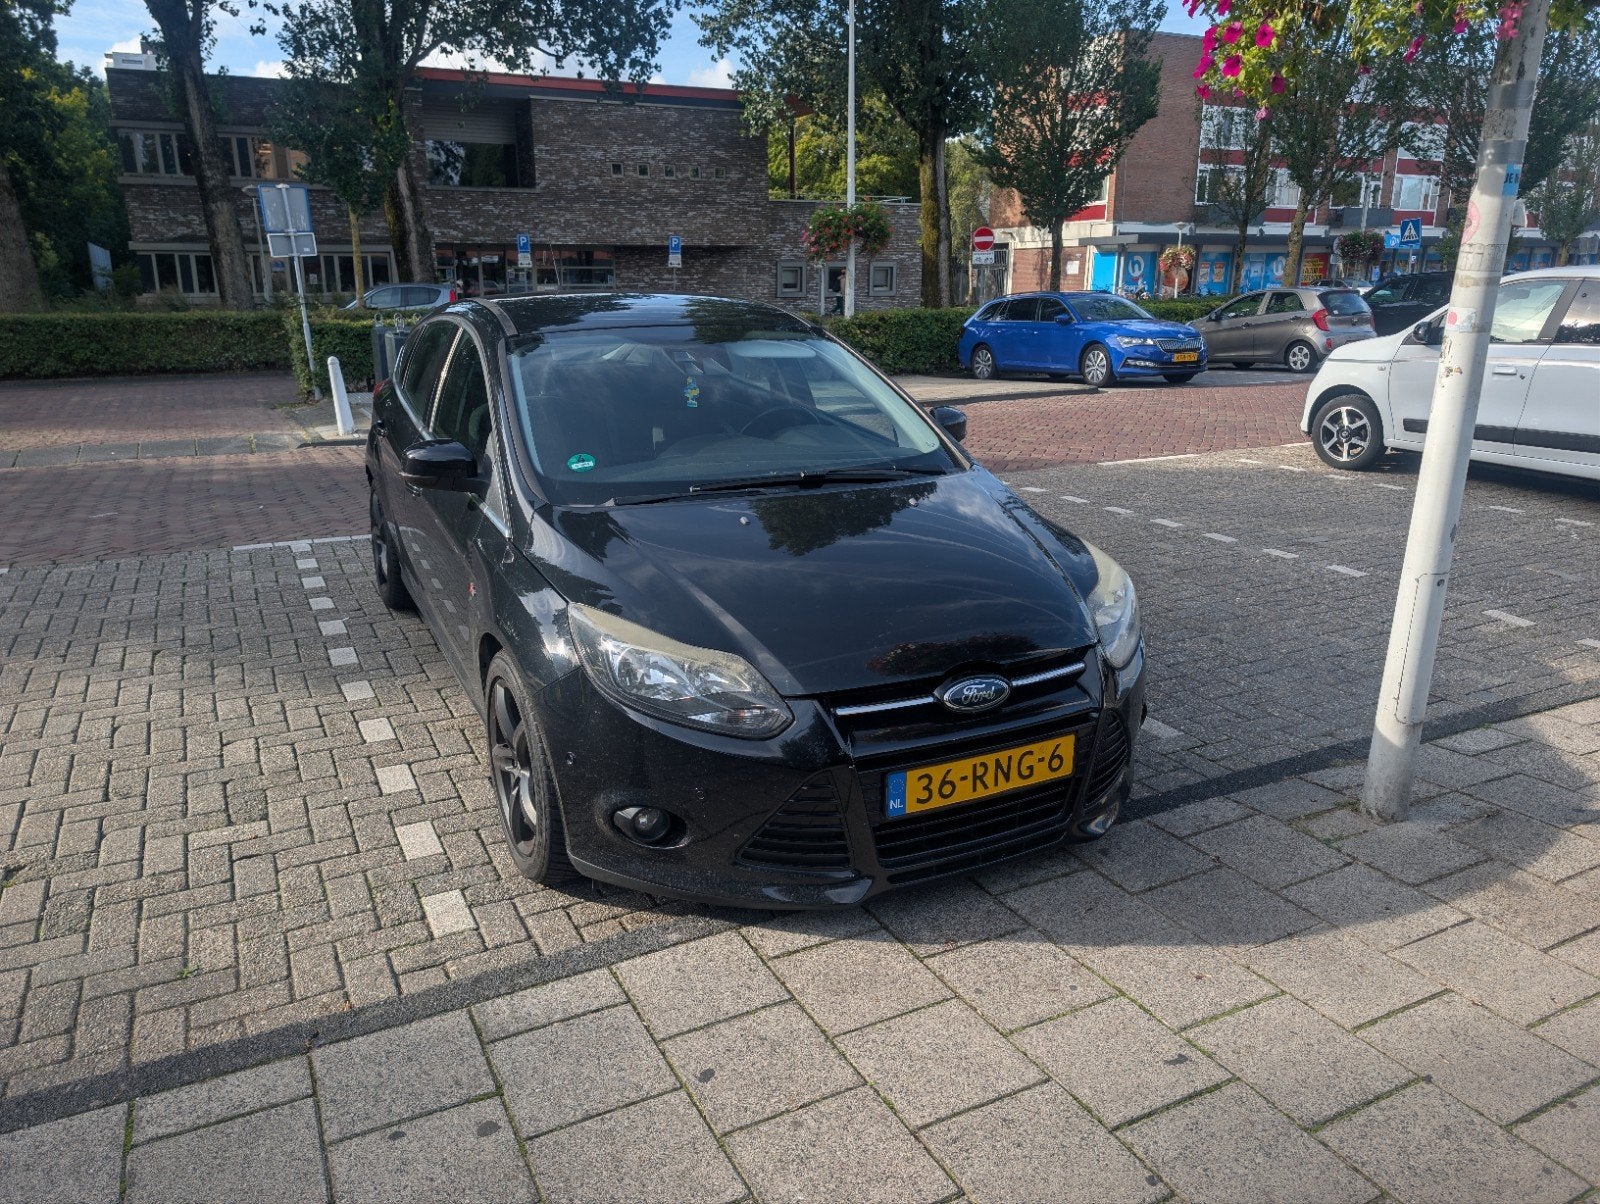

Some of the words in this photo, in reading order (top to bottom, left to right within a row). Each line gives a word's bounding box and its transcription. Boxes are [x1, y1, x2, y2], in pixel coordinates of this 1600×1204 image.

[520, 236, 527, 246] P
[672, 237, 679, 247] P
[962, 684, 996, 704] Ford
[916, 743, 1064, 804] 36-RNG-6
[889, 799, 904, 810] NL
